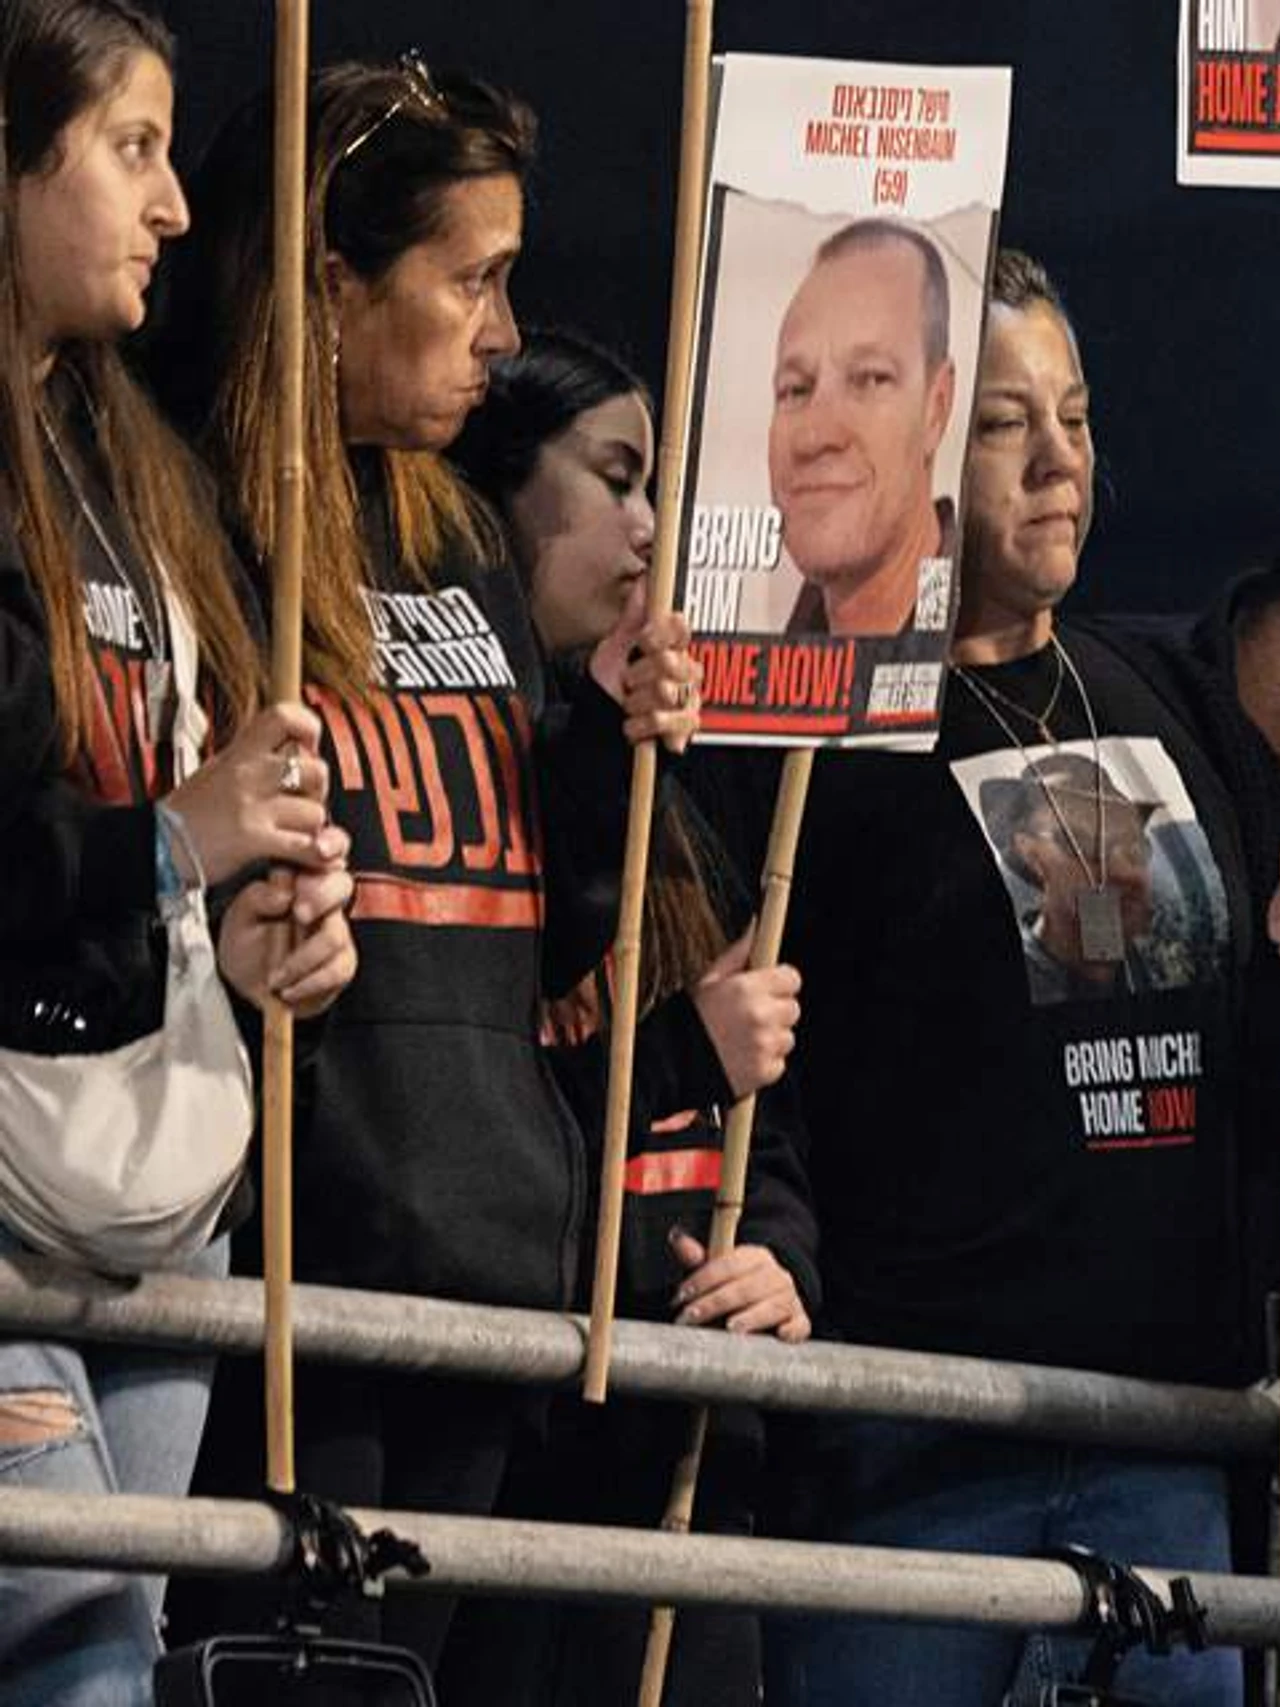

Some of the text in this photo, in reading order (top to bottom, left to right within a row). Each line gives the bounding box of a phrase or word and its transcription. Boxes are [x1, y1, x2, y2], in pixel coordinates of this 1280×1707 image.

[1197, 0, 1245, 52] HIM
[1197, 60, 1268, 123] HOME
[805, 120, 956, 161] MICHEL NISENBAUM
[873, 167, 909, 206] (59)
[689, 505, 782, 570] BRING
[684, 570, 741, 633] HIM
[690, 640, 759, 705] OME
[768, 639, 855, 708] NOW!
[303, 682, 541, 874] עכשי
[1064, 1037, 1134, 1087] BRING
[1080, 1089, 1145, 1135] HOME
